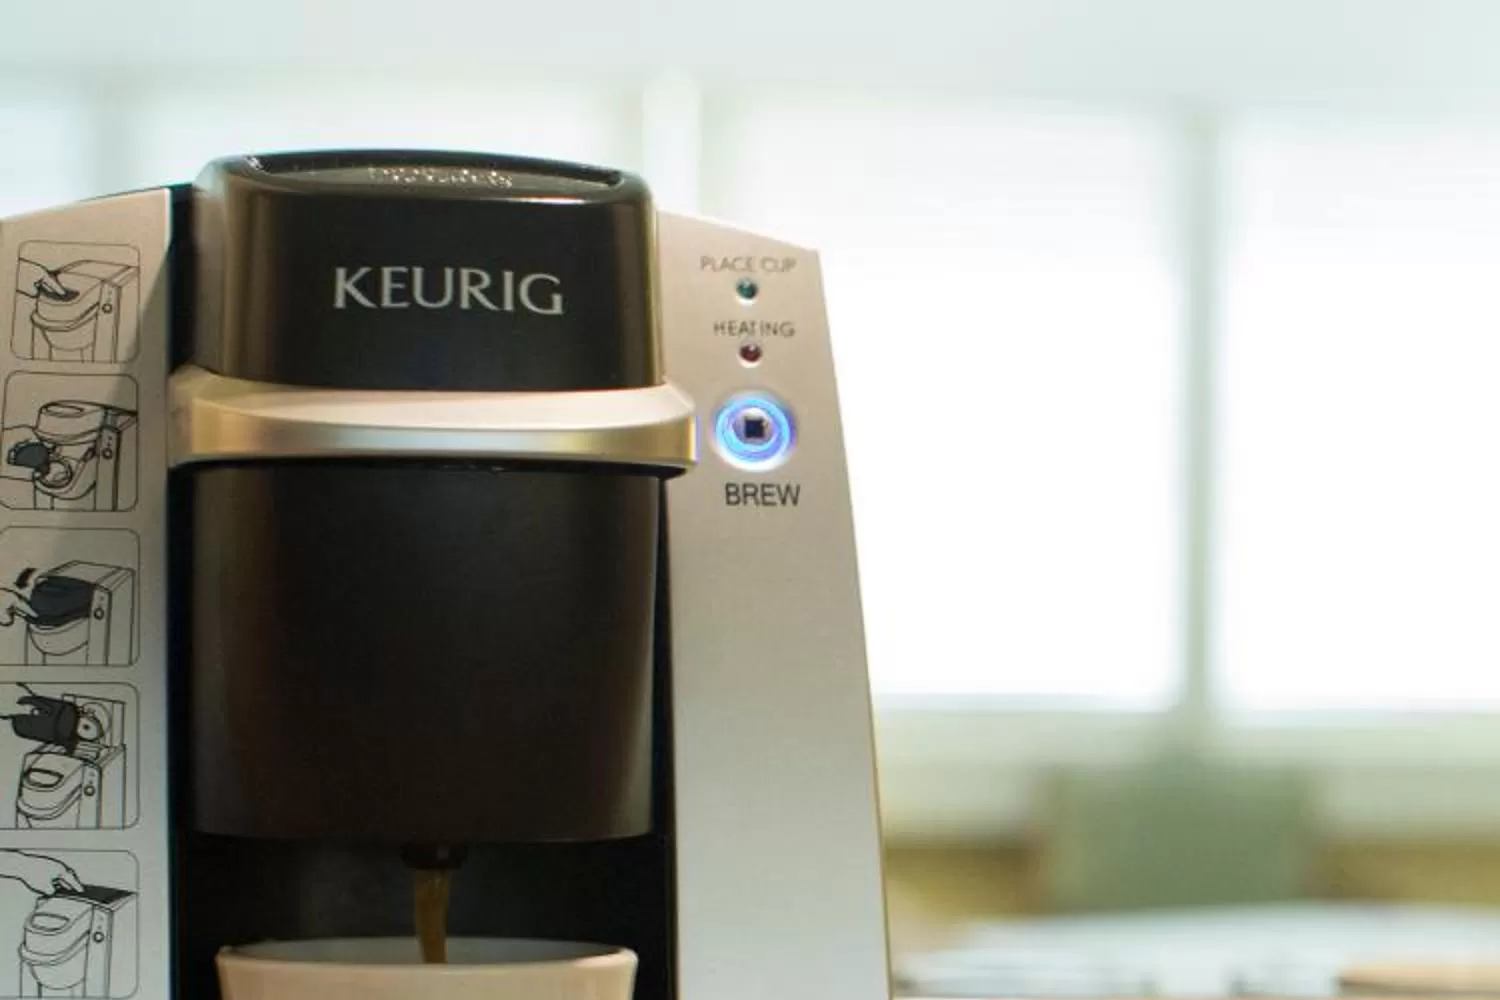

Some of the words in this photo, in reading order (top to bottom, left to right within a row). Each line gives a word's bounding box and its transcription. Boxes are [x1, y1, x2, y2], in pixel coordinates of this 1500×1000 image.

[760, 256, 797, 273] CUP
[333, 266, 564, 315] KEURIG
[713, 319, 796, 338] HEATING
[724, 483, 801, 506] BREW
